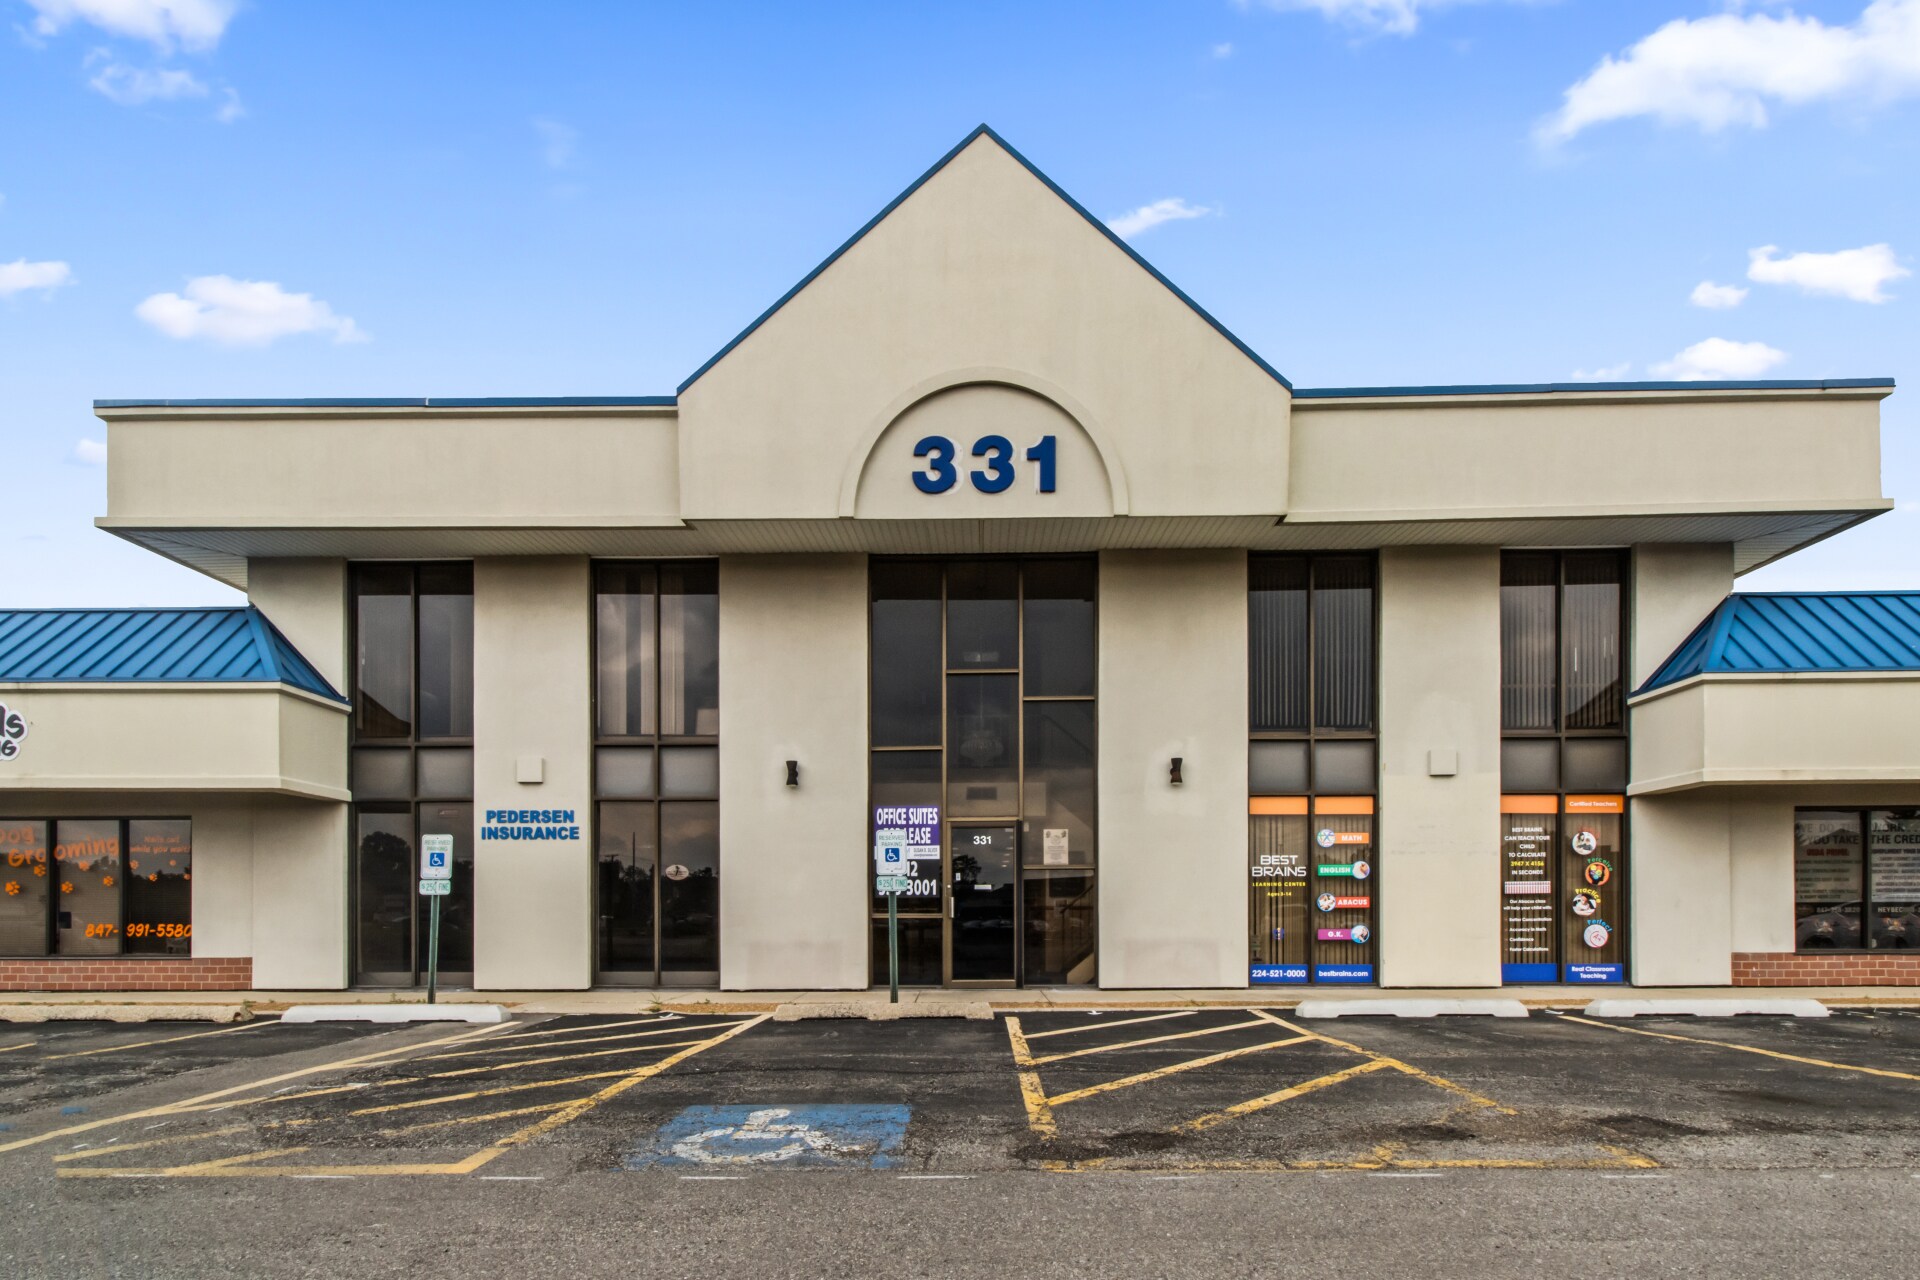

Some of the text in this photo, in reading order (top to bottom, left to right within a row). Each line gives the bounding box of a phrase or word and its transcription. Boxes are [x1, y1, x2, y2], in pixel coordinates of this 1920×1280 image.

[911, 435, 1056, 494] 331
[486, 810, 575, 824] PEDERSEN
[876, 807, 938, 825] OFFICE SUITES
[481, 826, 580, 840] INSURANCE
[973, 835, 992, 845] 331
[1833, 834, 1859, 845] TAKE
[1871, 834, 1891, 844] THE
[1260, 854, 1298, 865] BEST
[1251, 866, 1307, 877] BRAINS
[1252, 969, 1306, 978] 224-521-0000
[1318, 969, 1369, 977] bestbrains.com
